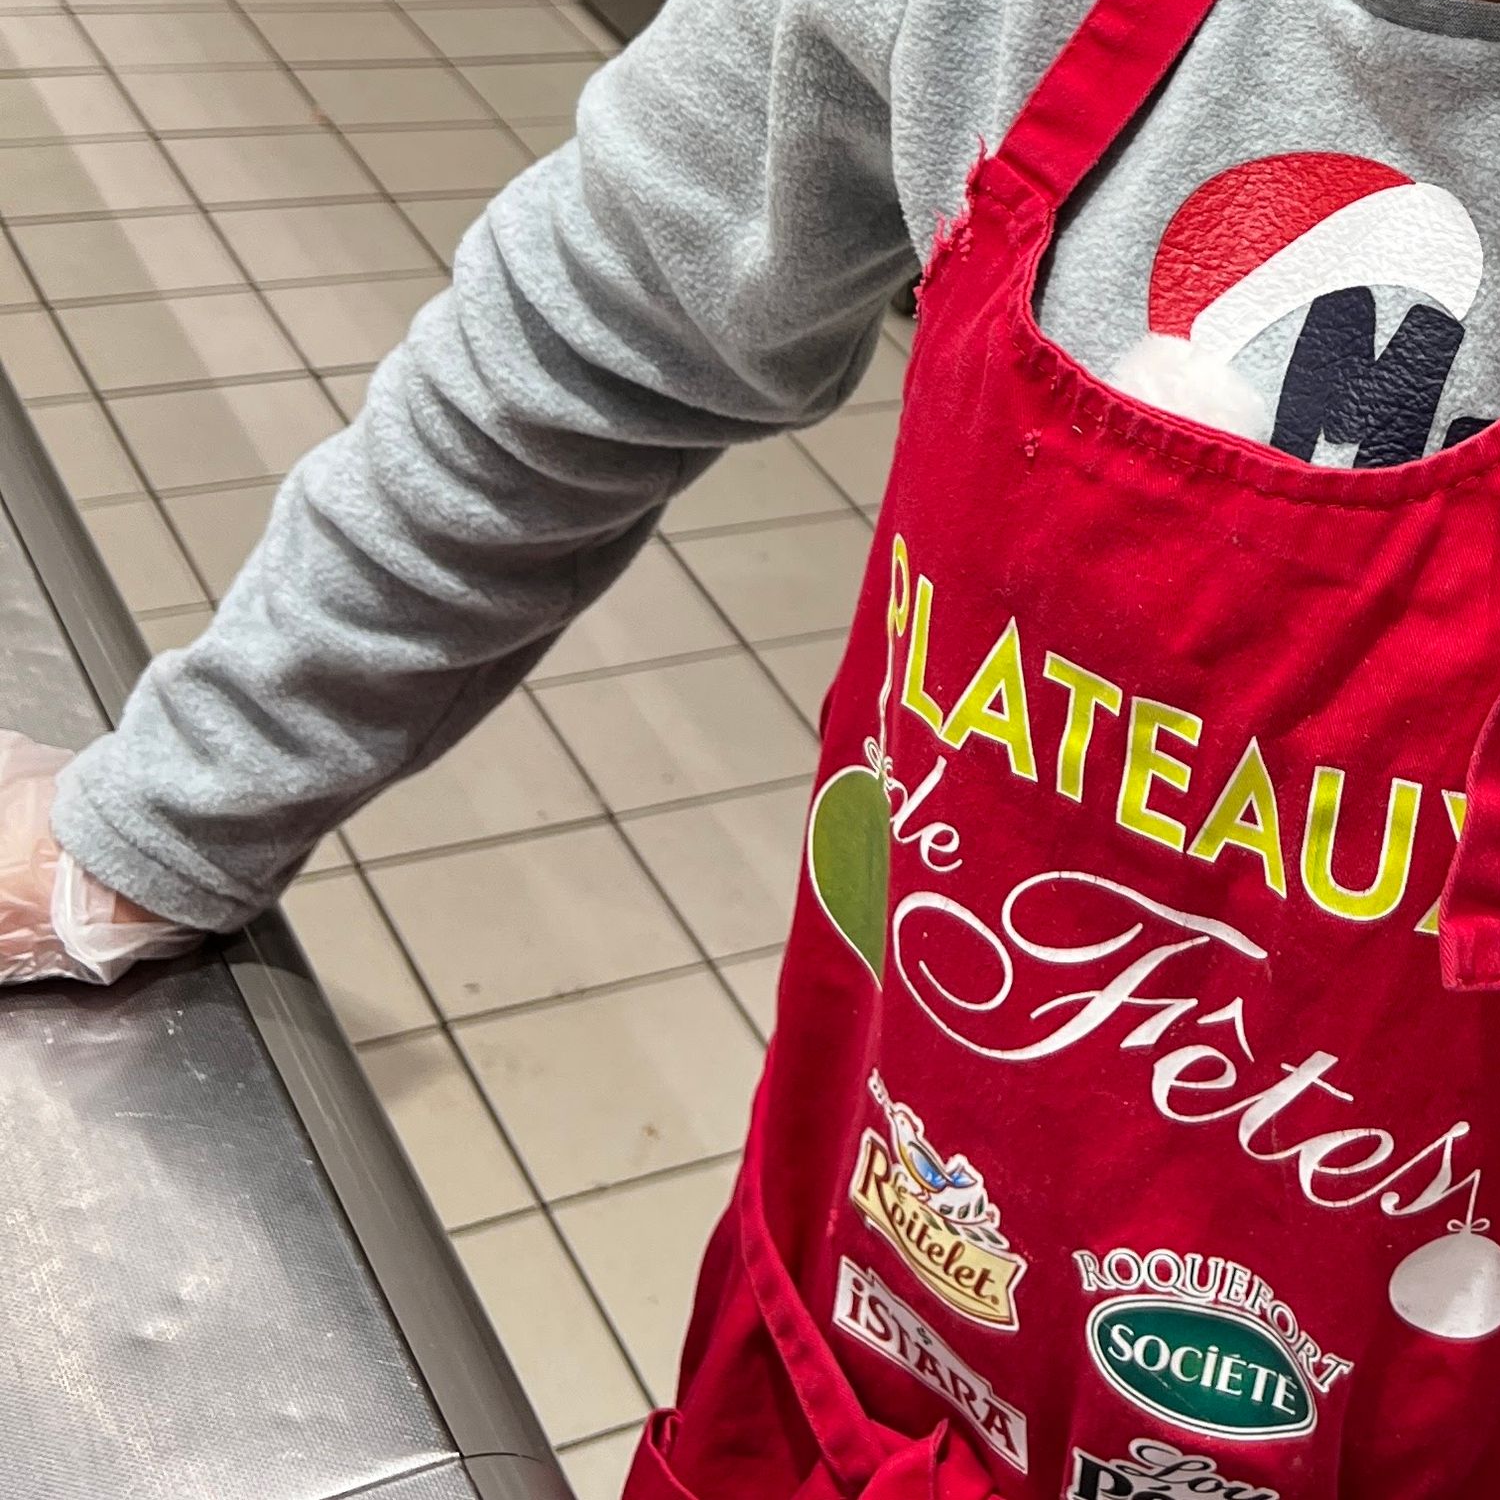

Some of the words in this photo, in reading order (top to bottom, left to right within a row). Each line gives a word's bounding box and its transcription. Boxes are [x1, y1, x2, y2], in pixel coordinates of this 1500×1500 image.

[886, 756, 965, 873] de
[892, 868, 1482, 1220] Fêtes
[857, 1134, 996, 1300] Roitelet
[1072, 1247, 1355, 1394] ROQUEFORT
